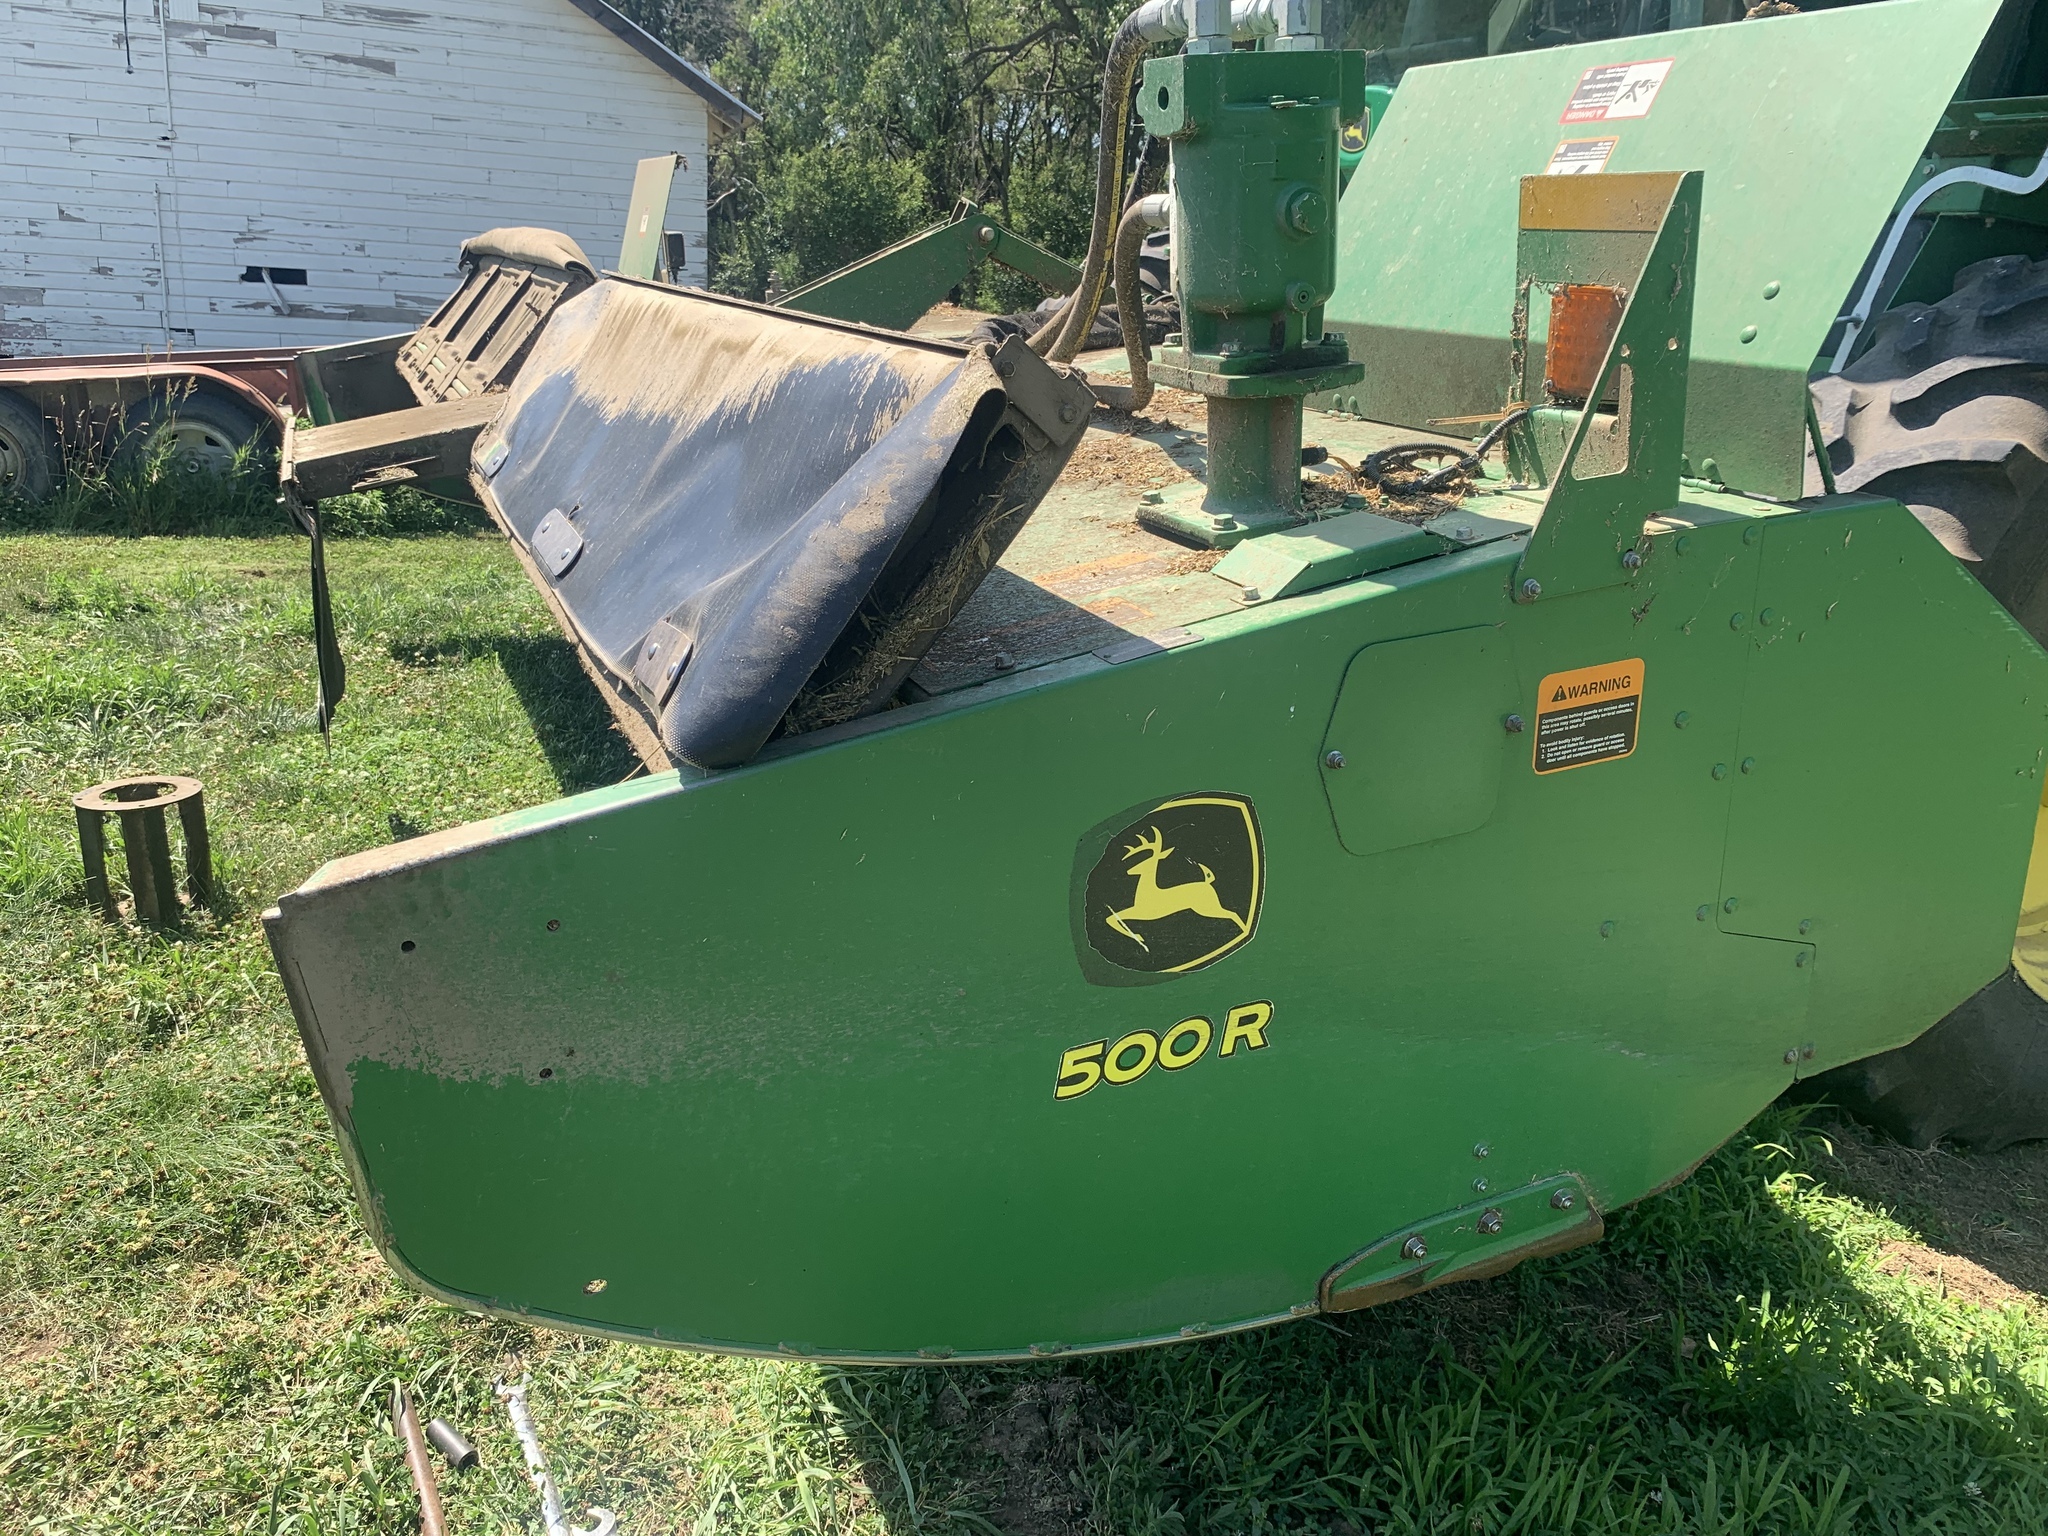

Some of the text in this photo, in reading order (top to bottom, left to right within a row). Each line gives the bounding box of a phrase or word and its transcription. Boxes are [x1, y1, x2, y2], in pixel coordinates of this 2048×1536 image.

[1568, 675, 1631, 699] WARNING
[1542, 715, 1568, 724] Components
[1569, 711, 1583, 719] behind
[1584, 709, 1597, 717] guards
[1583, 714, 1600, 722] possibly
[1593, 741, 1605, 749] guard
[1572, 749, 1597, 758] components
[1053, 999, 1274, 1101] 500 R
